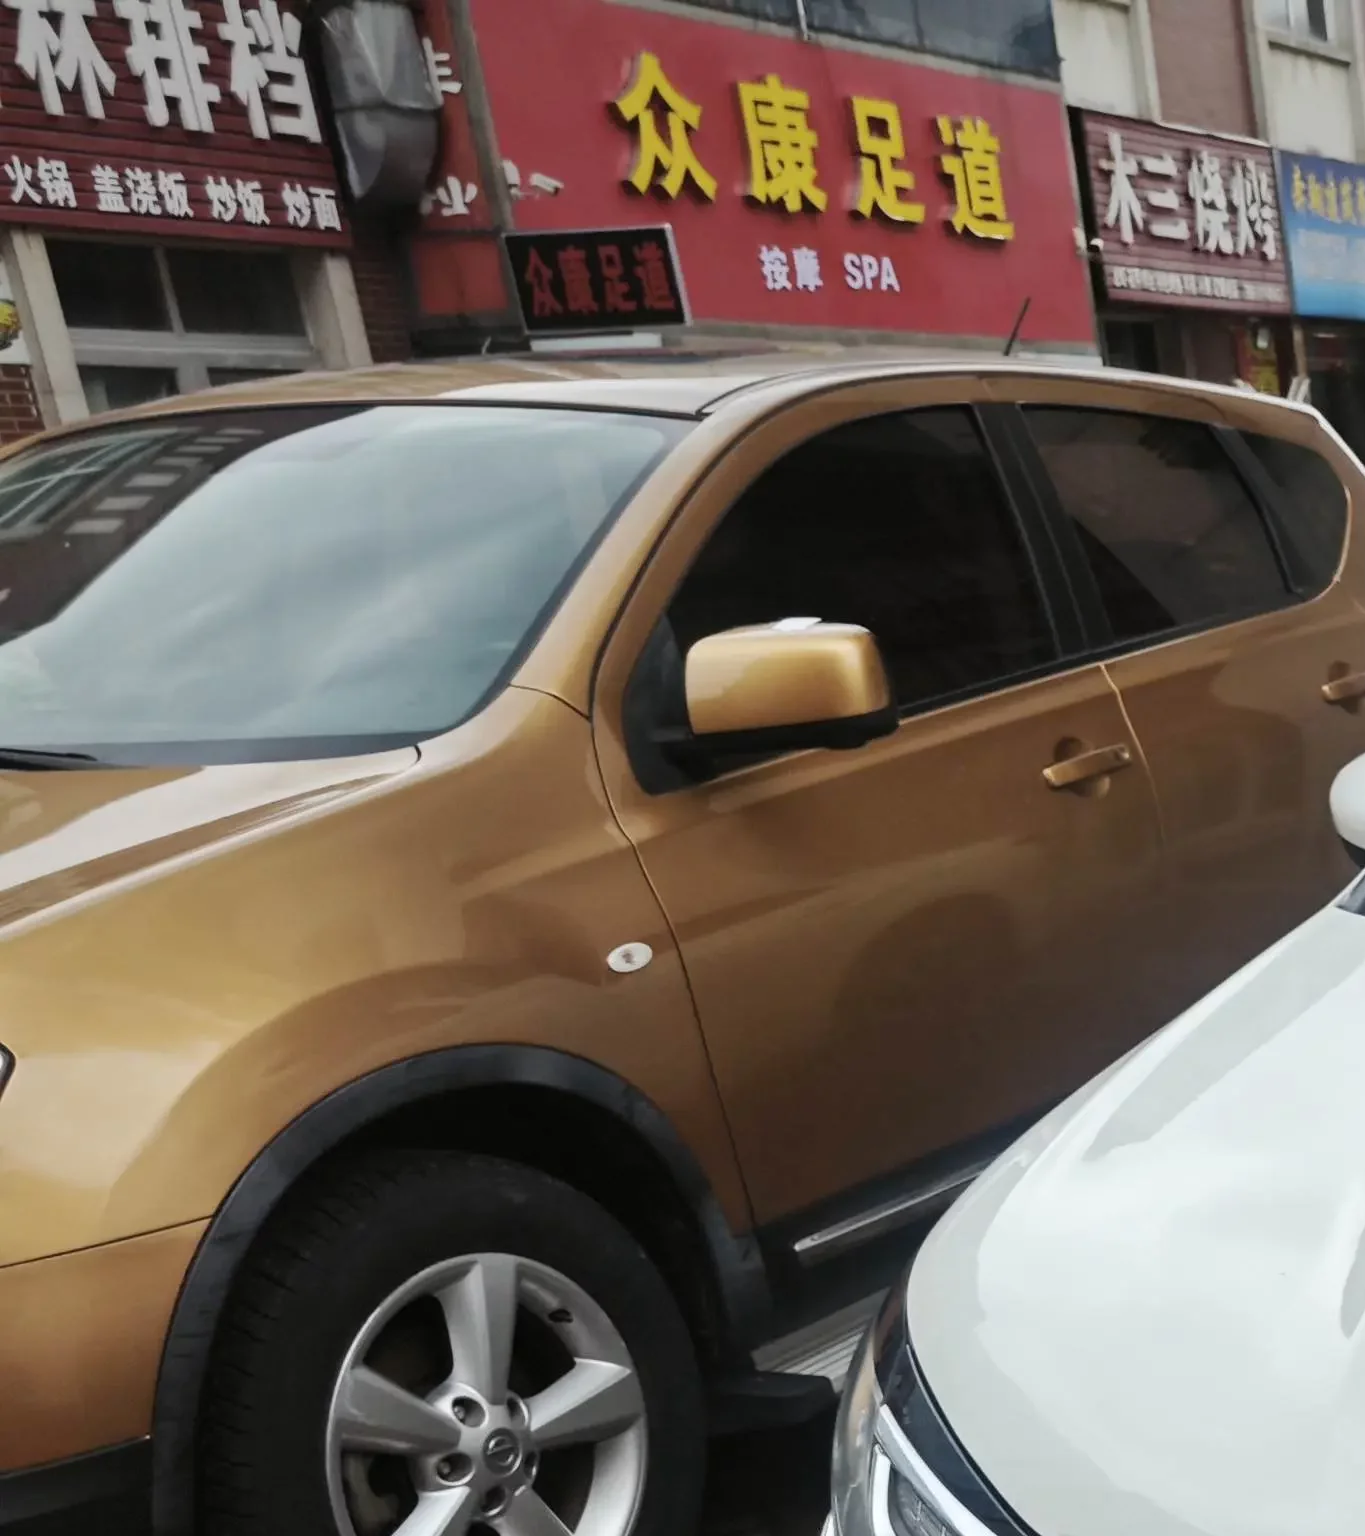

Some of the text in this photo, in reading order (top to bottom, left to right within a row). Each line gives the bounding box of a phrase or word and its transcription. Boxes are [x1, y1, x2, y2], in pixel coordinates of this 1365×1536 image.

[613, 50, 1015, 242] 众康足道
[4, 154, 342, 232] 火锅 盖浇饭 炒饭 炒面
[525, 242, 676, 318] 众康足道
[758, 244, 901, 292] 按摩 SPA
